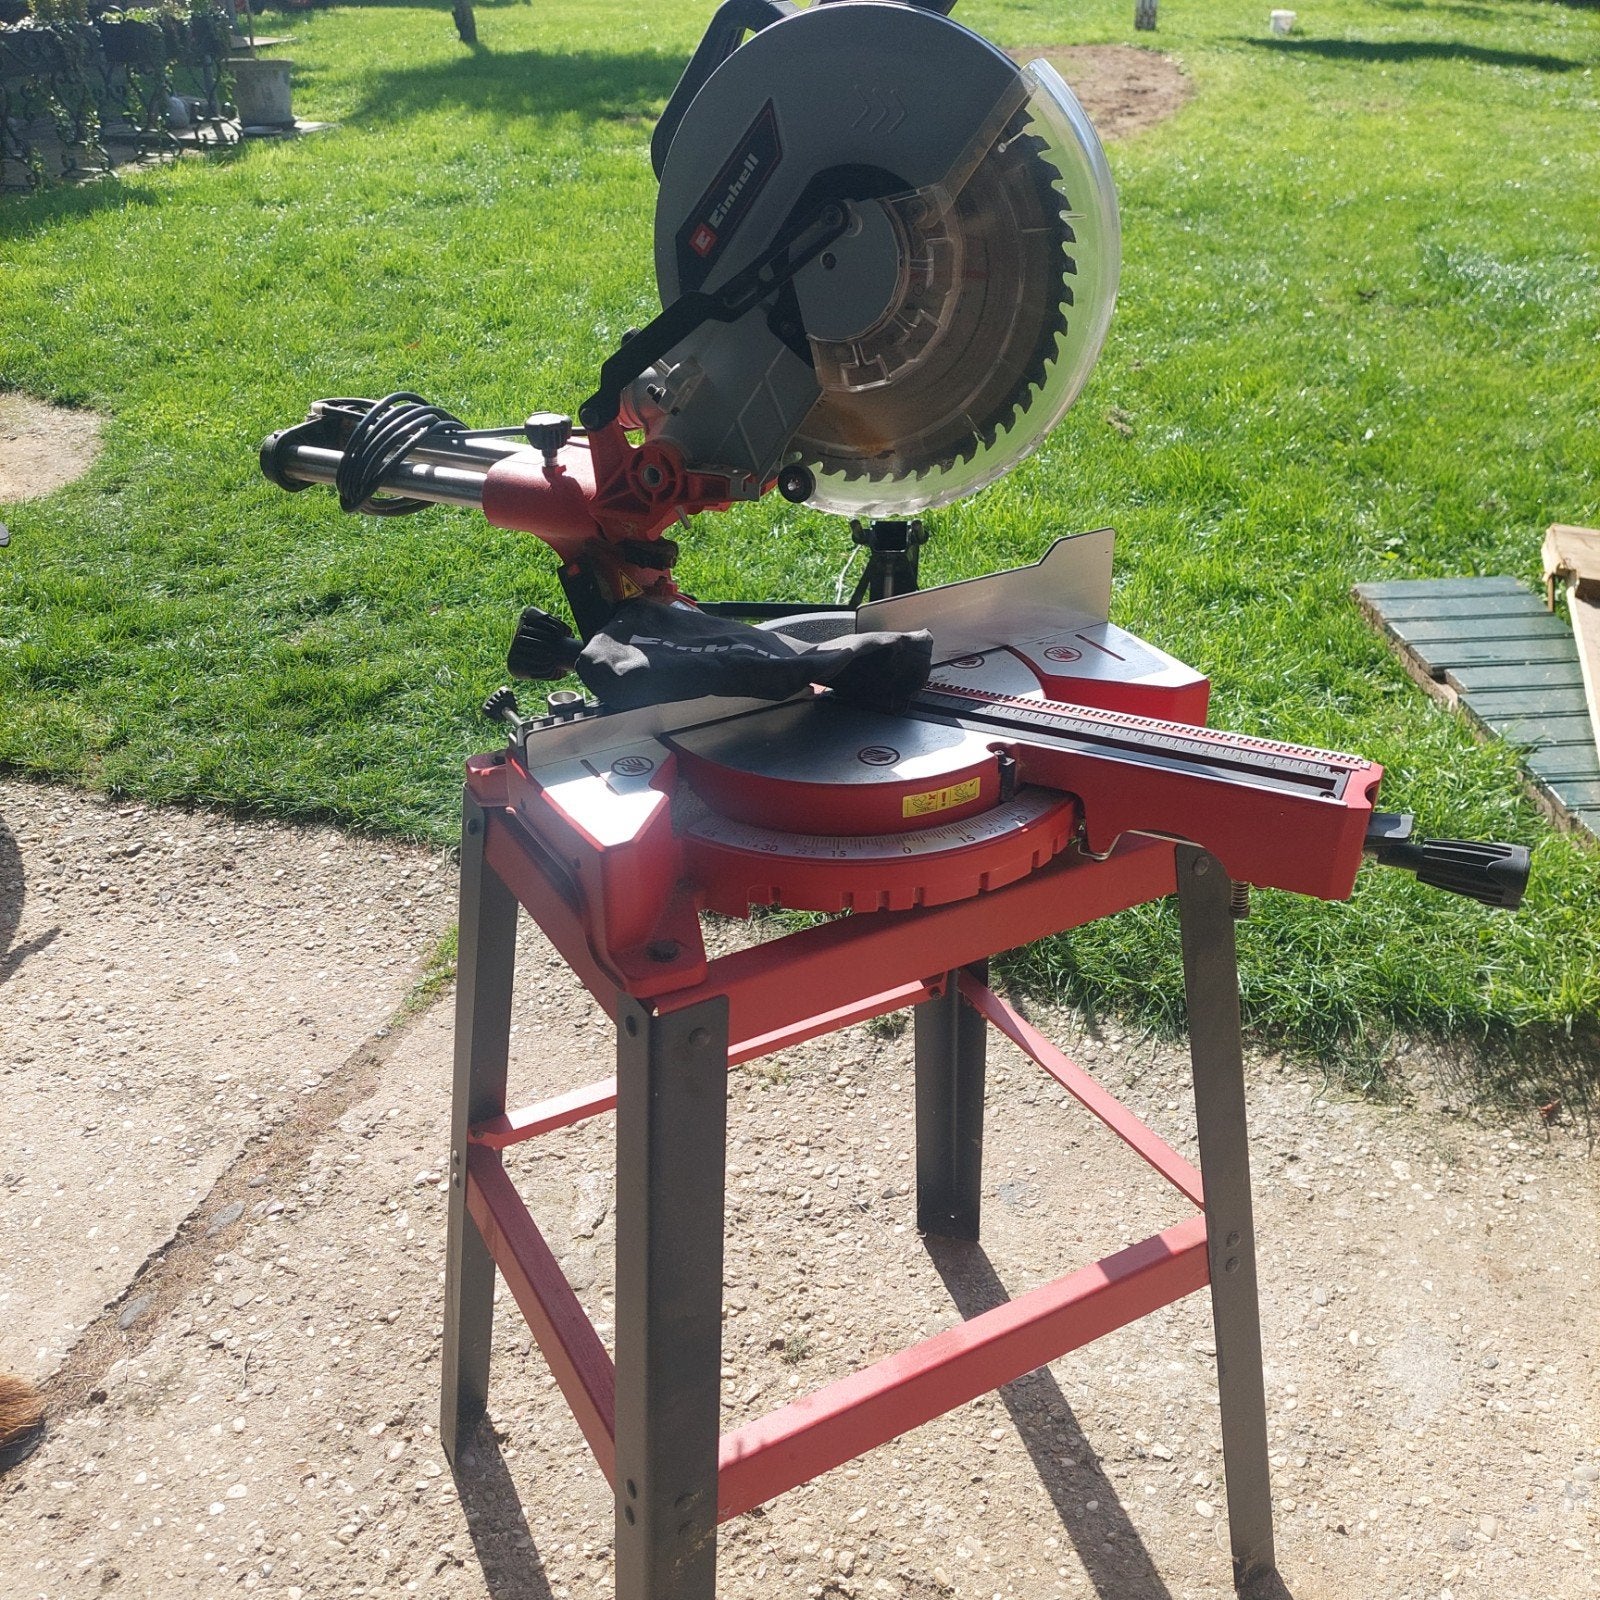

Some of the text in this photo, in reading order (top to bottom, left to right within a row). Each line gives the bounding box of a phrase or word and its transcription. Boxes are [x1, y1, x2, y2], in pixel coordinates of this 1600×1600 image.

[708, 152, 760, 228] Einhell
[902, 846, 912, 854] 0
[959, 834, 976, 843] 15
